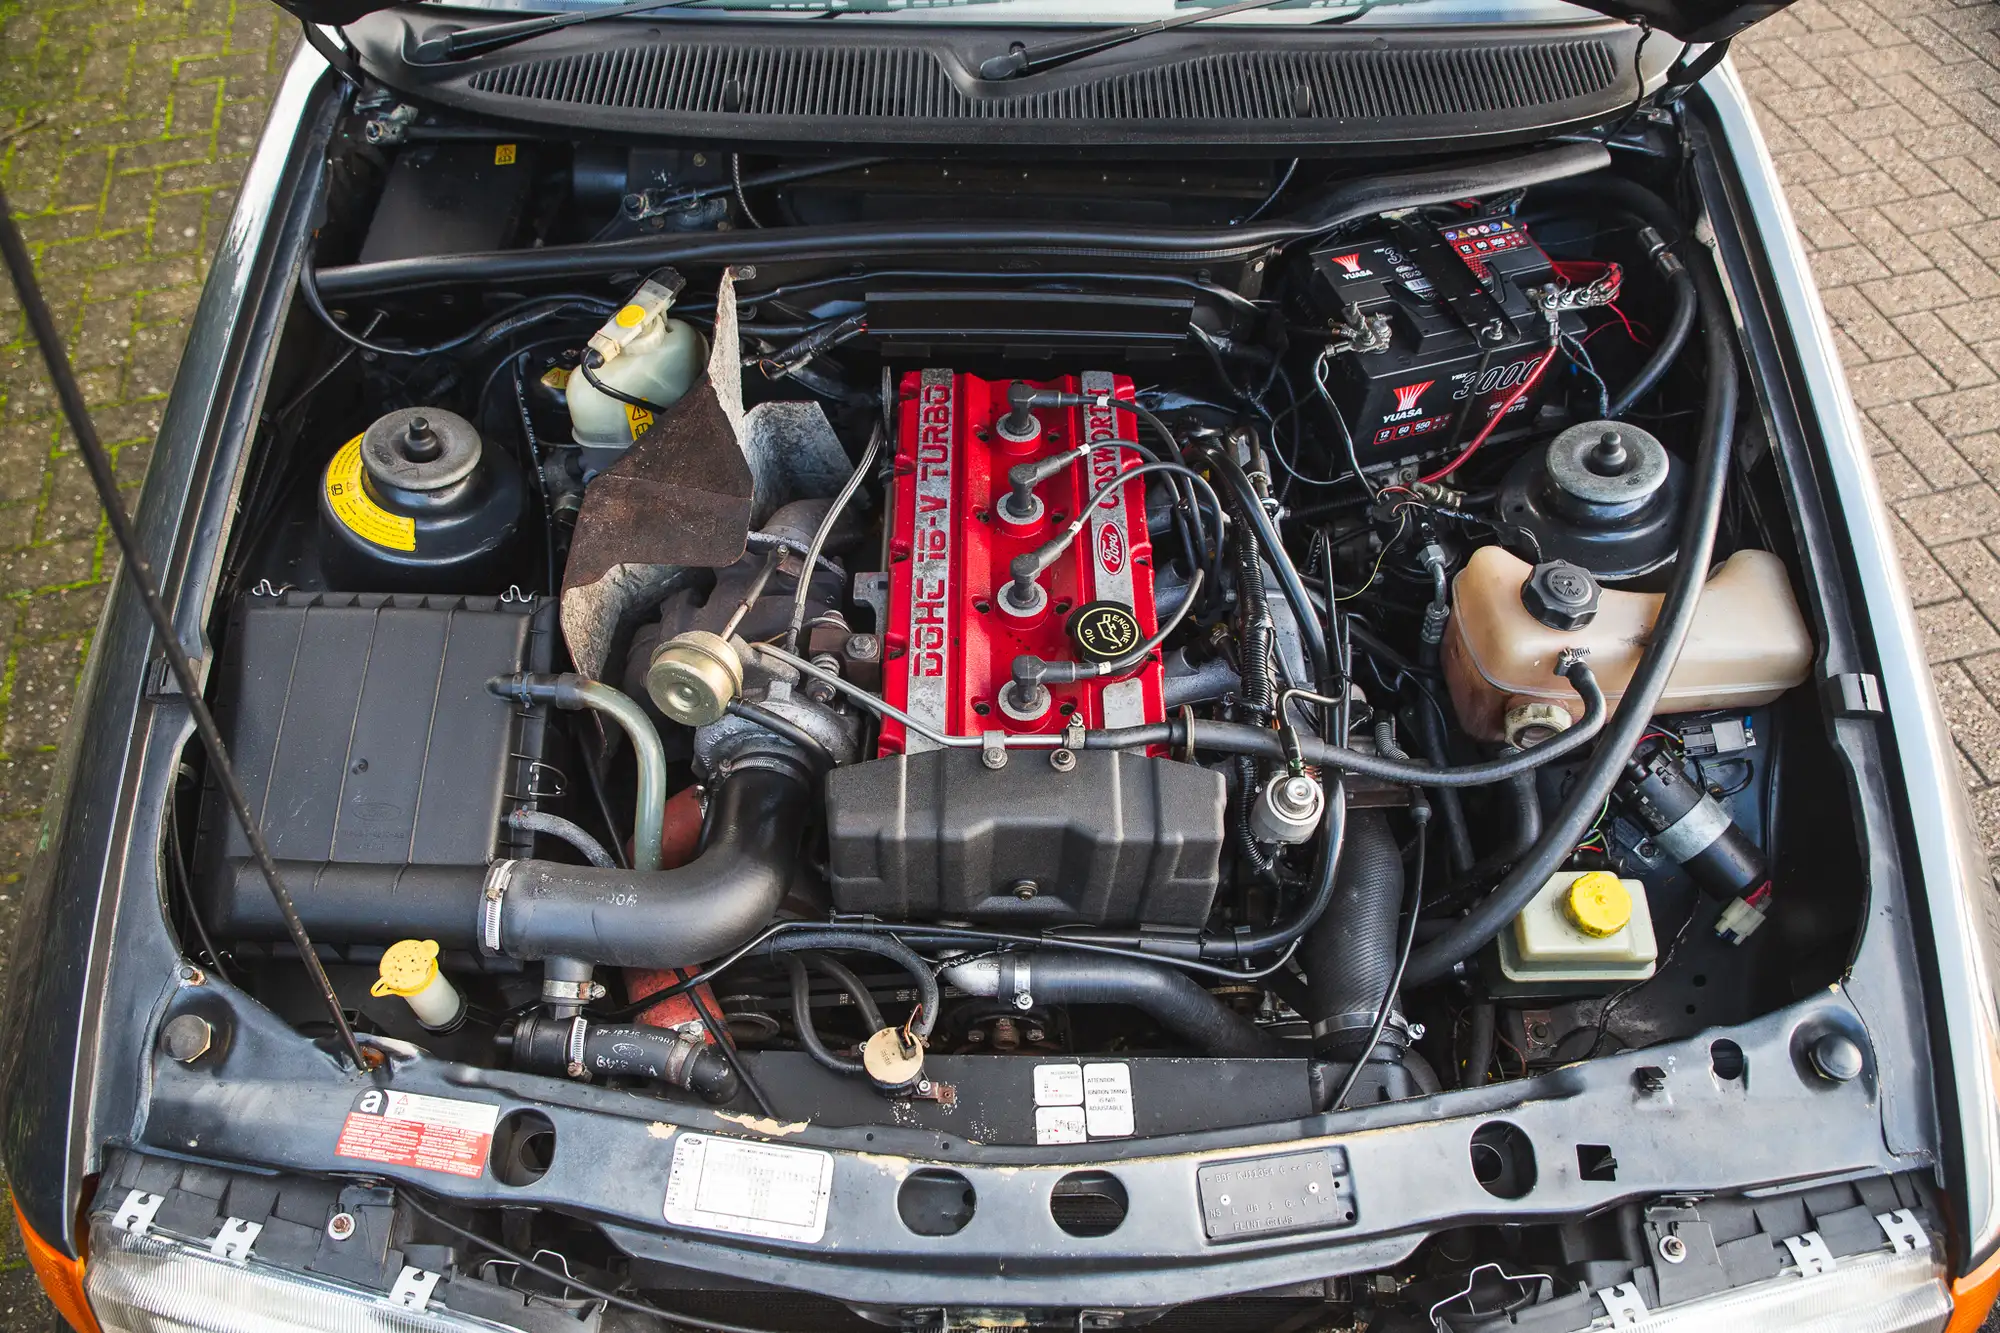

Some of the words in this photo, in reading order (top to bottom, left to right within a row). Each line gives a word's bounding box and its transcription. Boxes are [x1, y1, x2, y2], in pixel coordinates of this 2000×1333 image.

[1342, 269, 1373, 280] YUASA
[1383, 408, 1423, 423] YUASA
[921, 384, 951, 481] TURBO
[1380, 430, 1391, 439] 12
[1398, 425, 1410, 434] 60
[1415, 420, 1431, 431] 550
[913, 577, 945, 677] DOHC
[1084, 628, 1096, 644] OIL
[1112, 614, 1132, 644] ENGINE
[359, 1090, 383, 1114] a
[1233, 1220, 1262, 1231] FLINT
